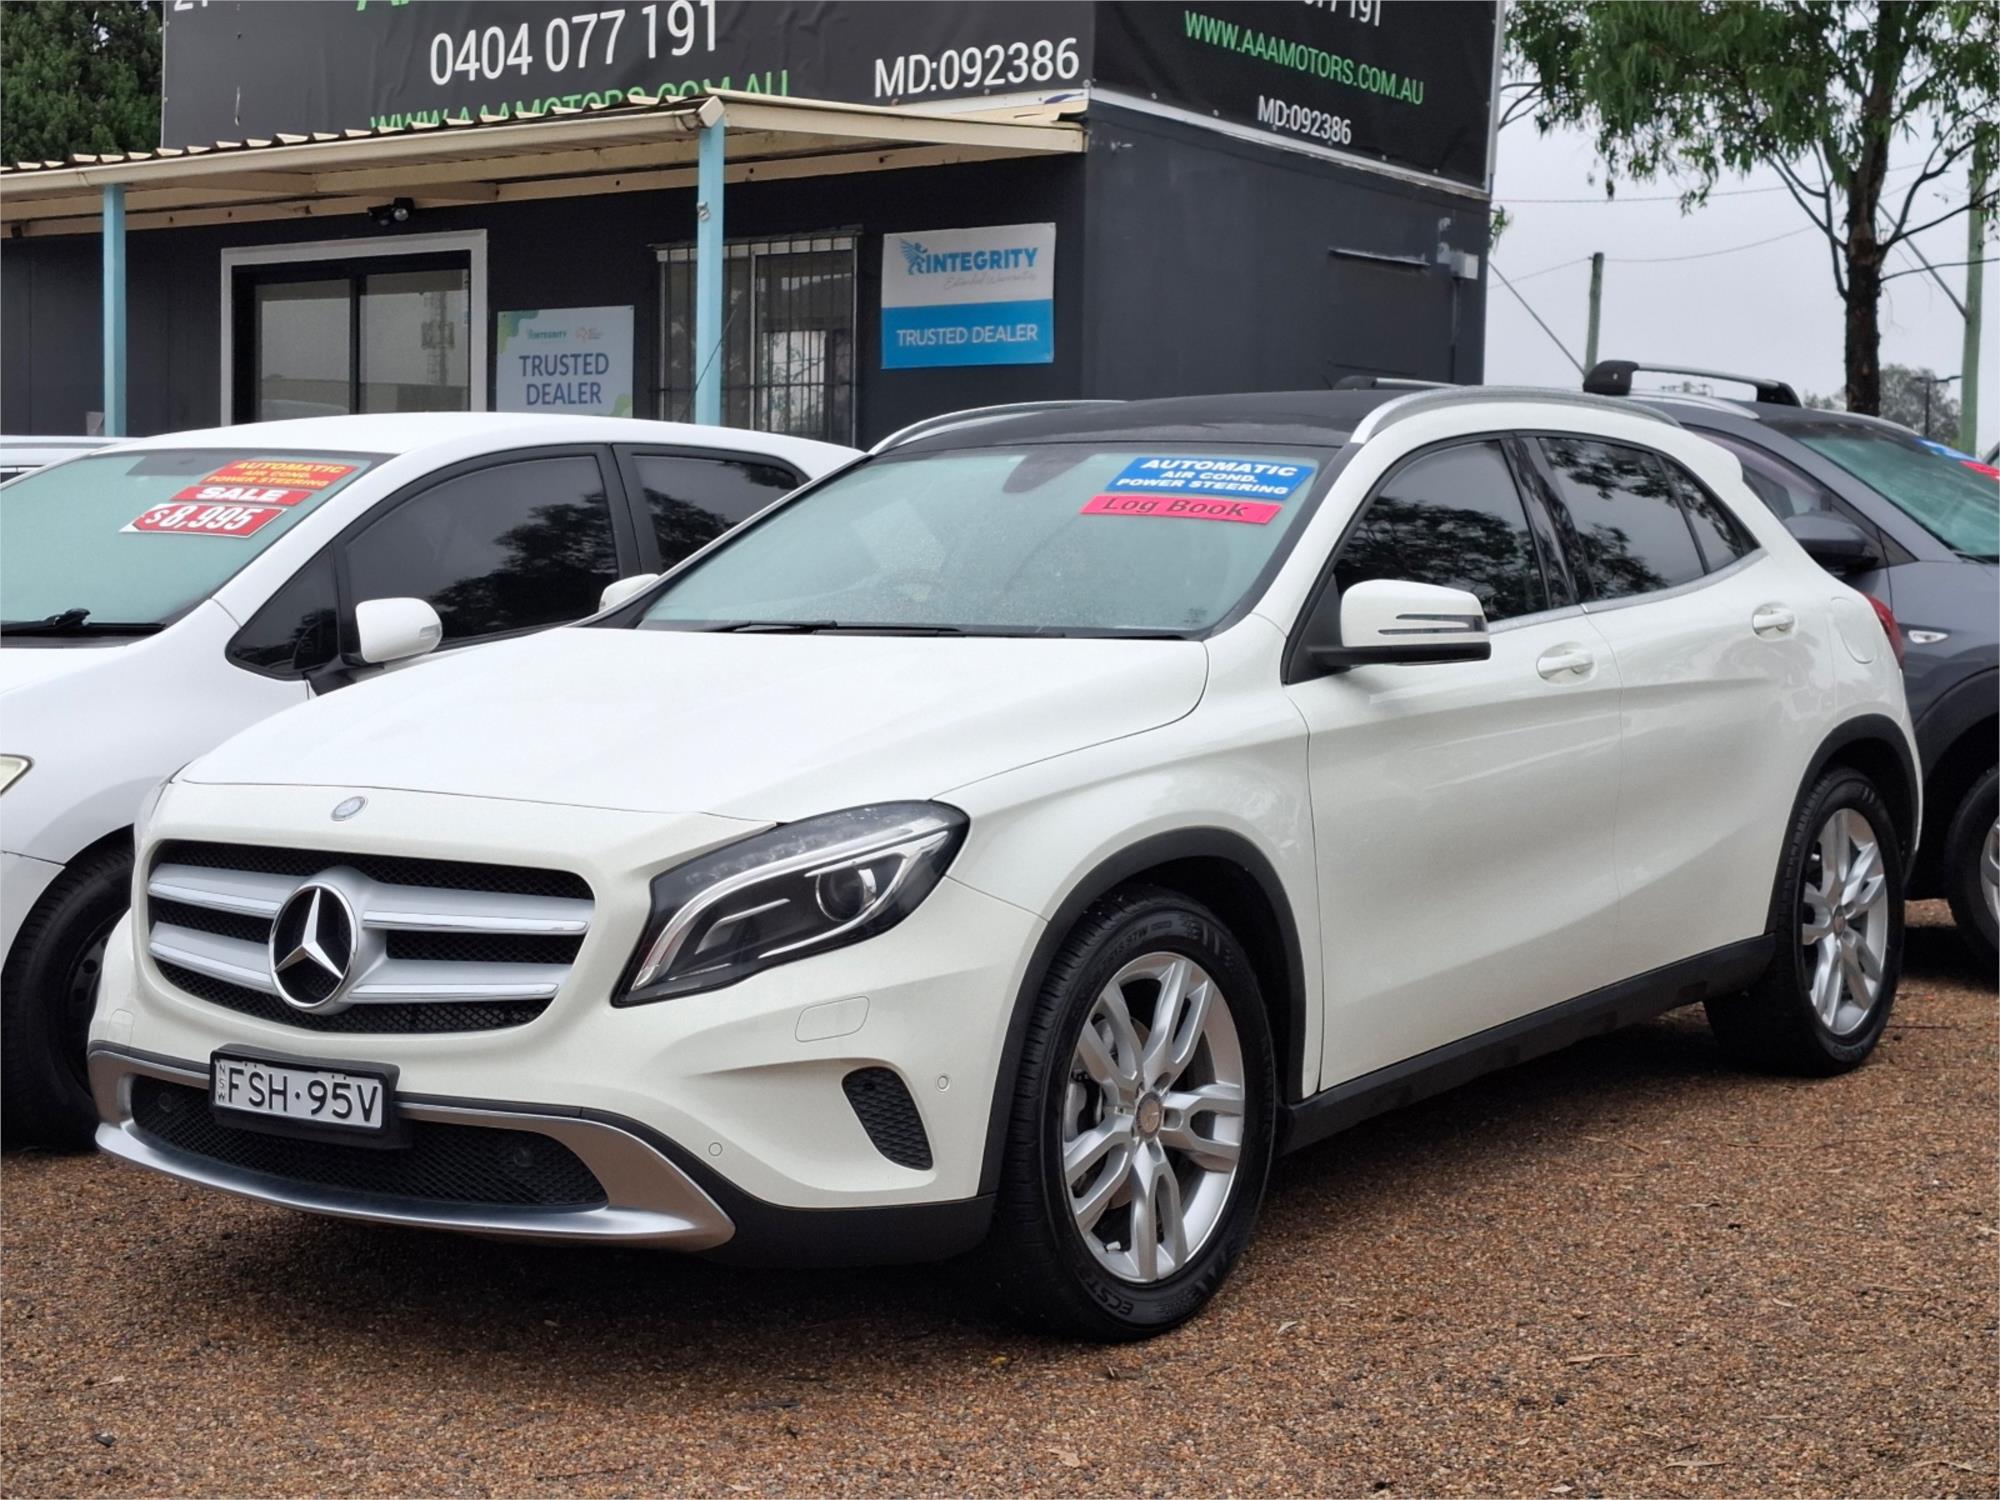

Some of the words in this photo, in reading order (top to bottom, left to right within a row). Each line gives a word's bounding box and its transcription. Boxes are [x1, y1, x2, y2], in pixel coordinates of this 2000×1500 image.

[430, 22, 533, 86] 0404
[545, 9, 627, 73] 077
[641, 0, 717, 60] 191
[873, 36, 1082, 98] MD:092386
[1184, 9, 1425, 105] WWW.AAAMOTORS.COM.AU
[1257, 94, 1353, 145] MD:092386
[926, 249, 1039, 273] INTEGRITY
[896, 326, 969, 348] TRUSTED
[972, 323, 1039, 344] DEALER
[519, 352, 610, 377] TRUSTED
[526, 381, 603, 406] DEALER
[232, 462, 346, 473] AUTOMATIC
[1140, 459, 1298, 476] AUTOMATIC
[1160, 470, 1196, 479] AIR
[1198, 472, 1259, 483] COND.
[196, 487, 288, 500] SALE
[1115, 478, 1184, 488] POWER
[1188, 480, 1289, 495] STEERING
[144, 505, 263, 530] $8,995
[1102, 498, 1159, 513] Log
[1167, 499, 1249, 517] Book
